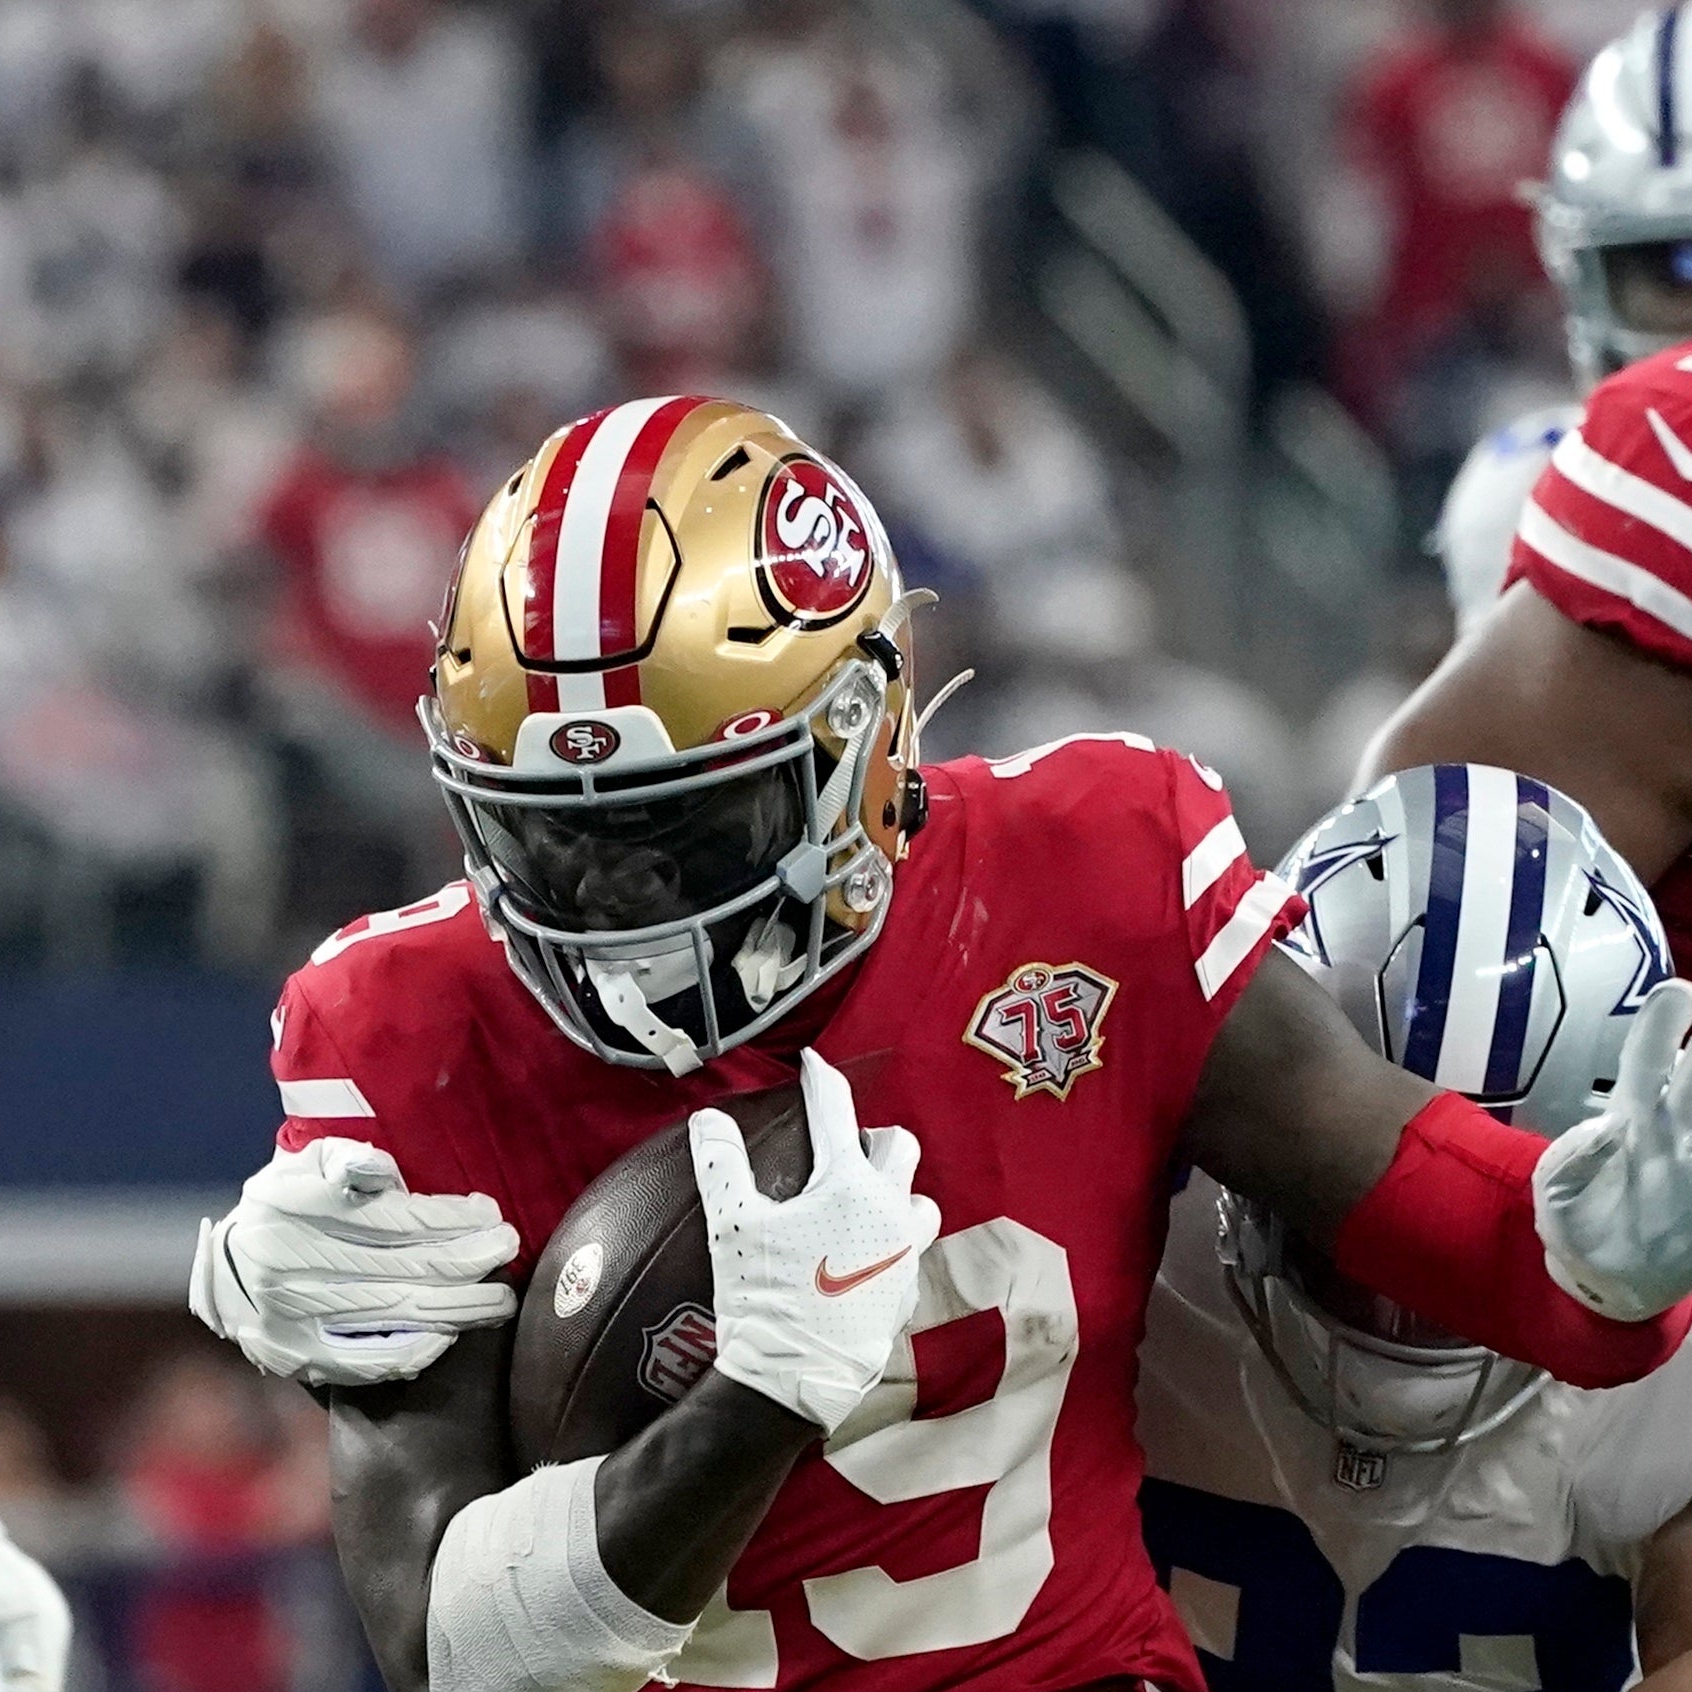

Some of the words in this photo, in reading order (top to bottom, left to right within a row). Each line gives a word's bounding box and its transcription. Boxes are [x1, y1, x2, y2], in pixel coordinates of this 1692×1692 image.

[566, 726, 607, 760] SF
[997, 983, 1089, 1066] 75
[649, 1313, 717, 1390] NFL
[653, 1215, 1079, 1689] 9
[1341, 1455, 1381, 1486] NFL
